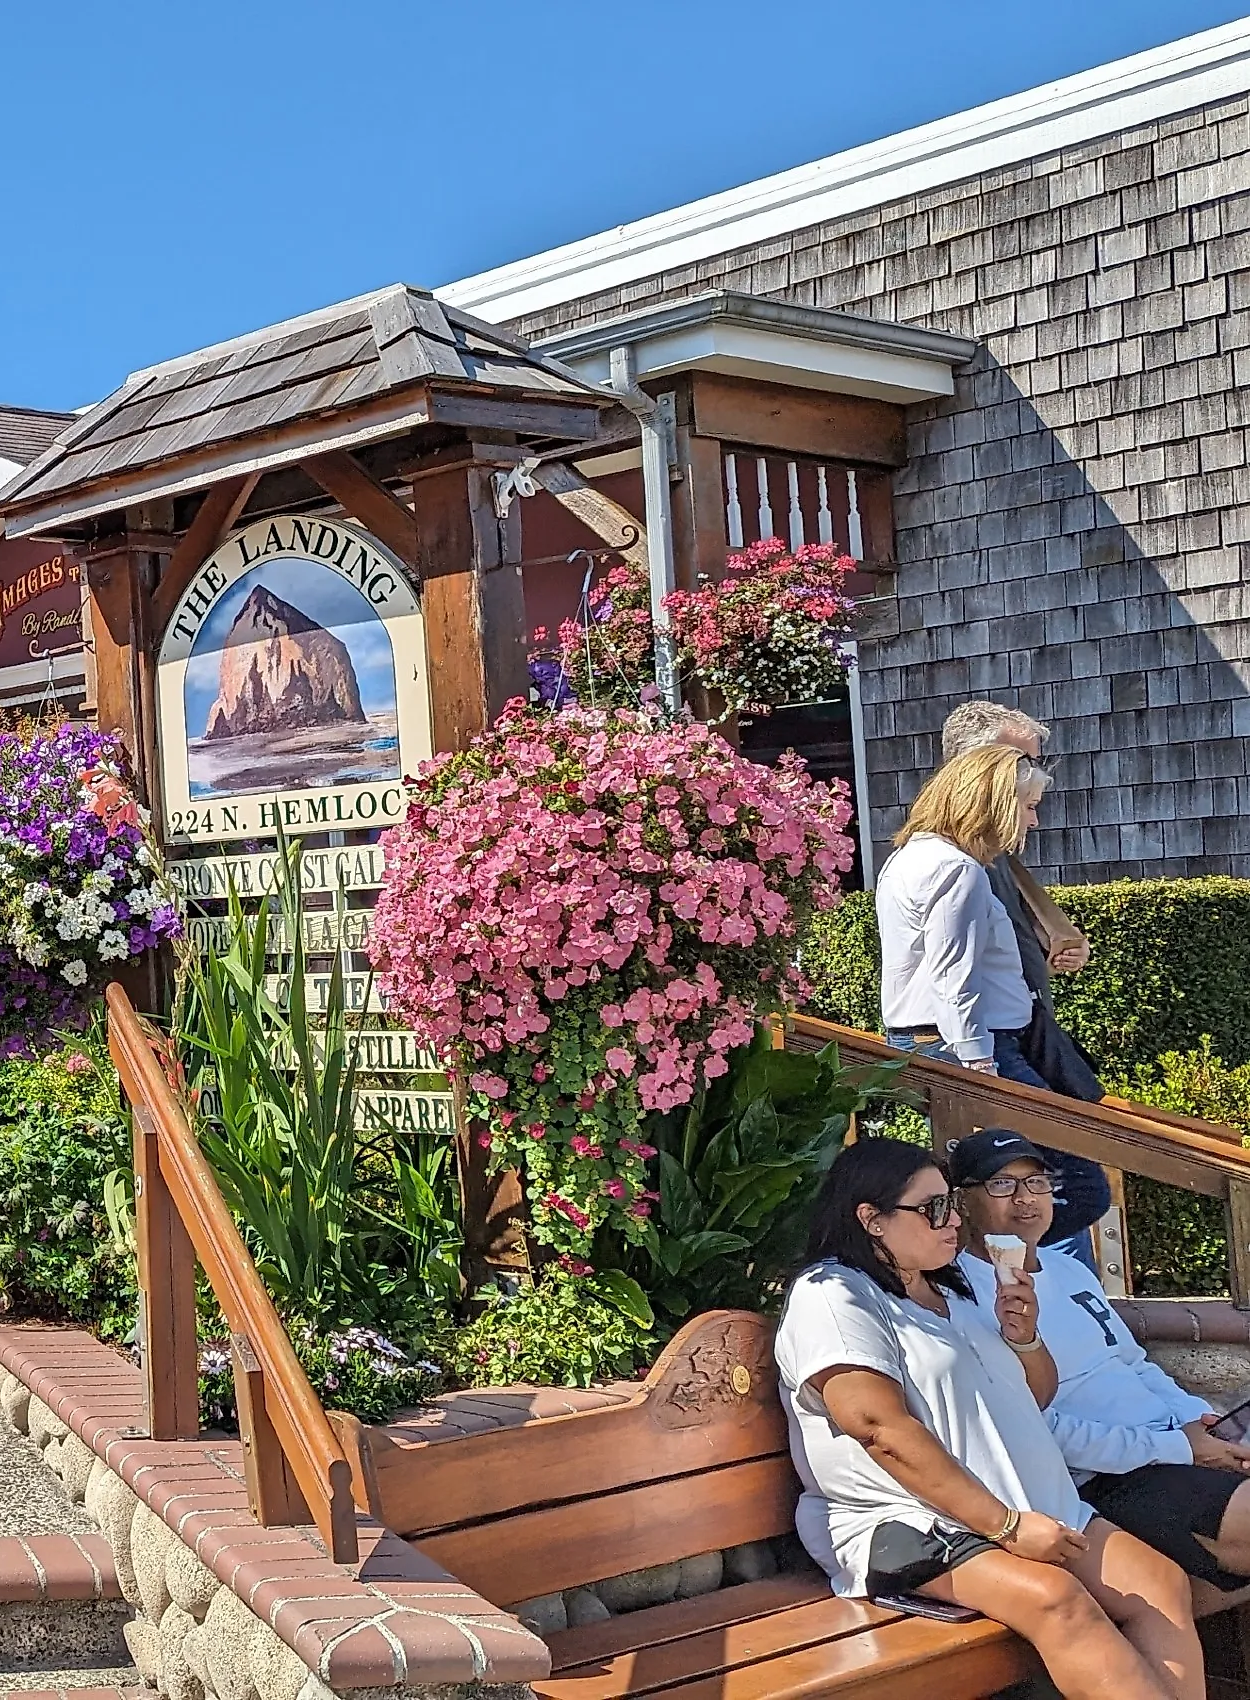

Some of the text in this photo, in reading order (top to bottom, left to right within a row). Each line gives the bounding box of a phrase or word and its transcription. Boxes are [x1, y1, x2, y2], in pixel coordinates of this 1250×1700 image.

[173, 518, 398, 643] THE LANDING
[21, 609, 78, 638] By Rand
[171, 787, 416, 836] 224 N. HEMLOC
[1069, 1290, 1118, 1347] P
